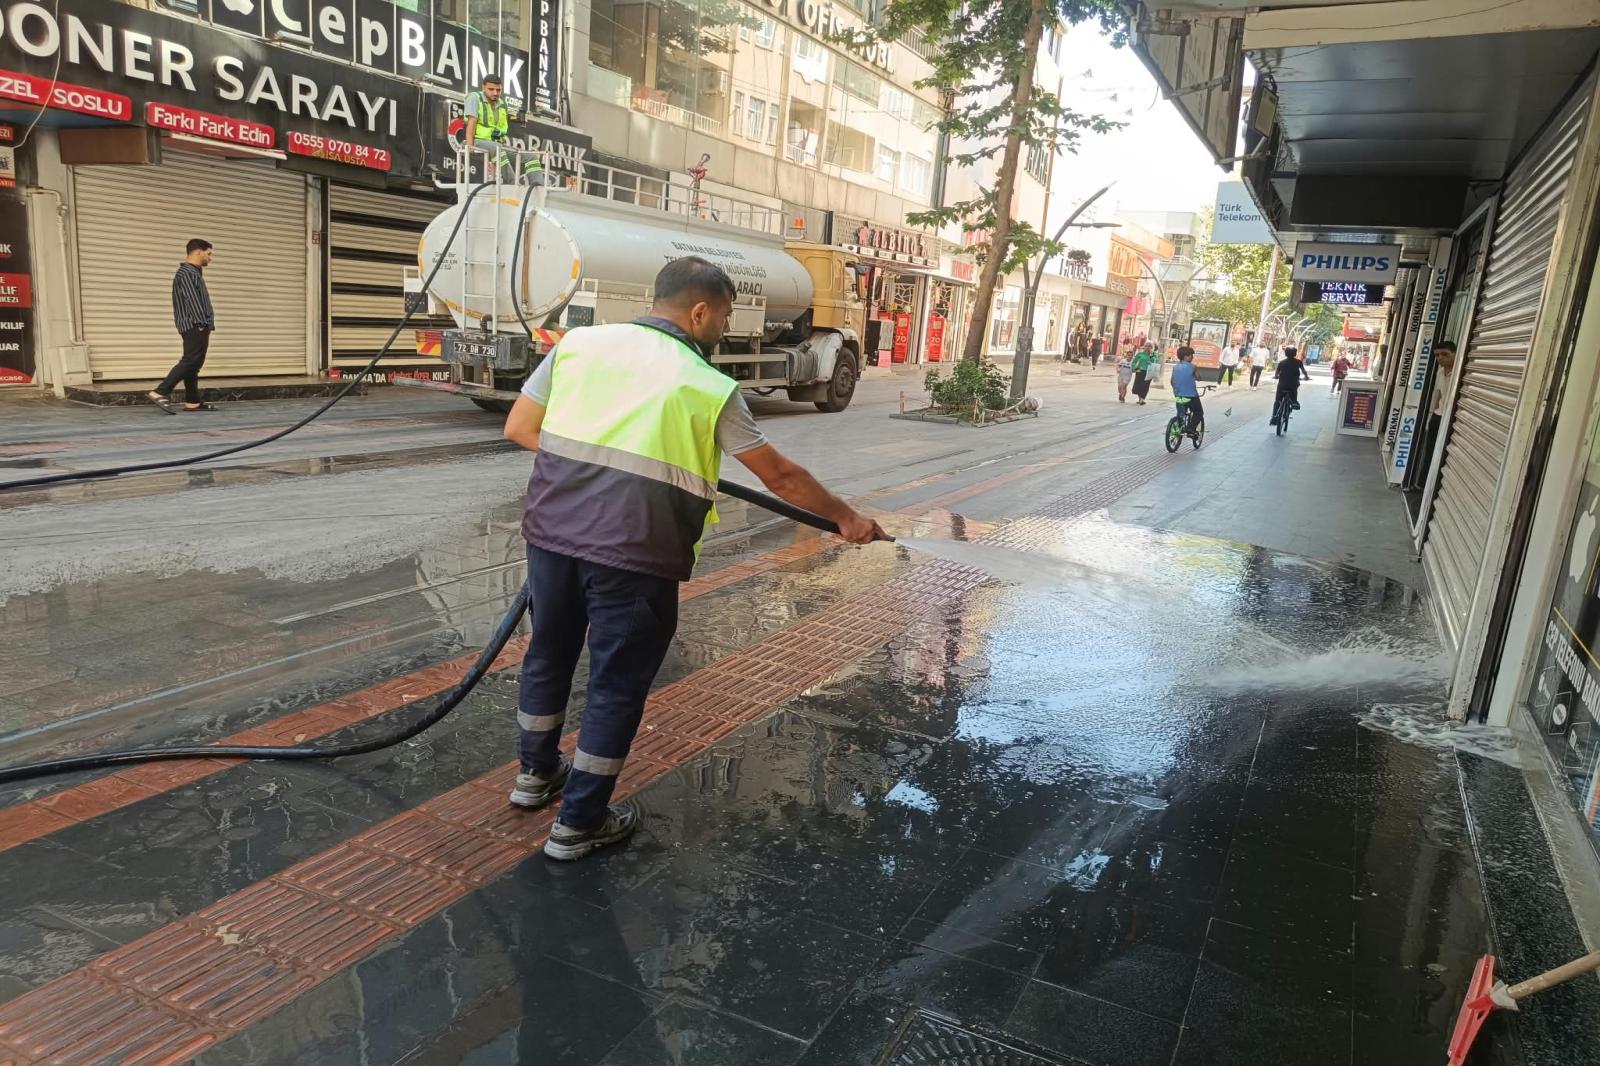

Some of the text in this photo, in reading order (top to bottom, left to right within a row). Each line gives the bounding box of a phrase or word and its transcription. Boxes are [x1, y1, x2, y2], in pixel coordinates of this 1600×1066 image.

[53, 88, 122, 116] SOSLU
[214, 56, 397, 137] SARAYI
[153, 106, 270, 145] Farkı Fark Edin
[293, 132, 387, 161] 0555 070 84 72
[1218, 212, 1261, 222] Telekom
[1219, 203, 1242, 212] Türk
[1301, 254, 1390, 271] PHILIPS
[736, 281, 763, 296] ARACI
[1410, 292, 1424, 333] KORKMAZ
[432, 371, 450, 381] KILIF
[1399, 348, 1413, 388] KORKMAZ
[1396, 416, 1415, 468] PHILPS
[1546, 619, 1560, 652] CEP
[1555, 633, 1587, 694] TELEFONU
